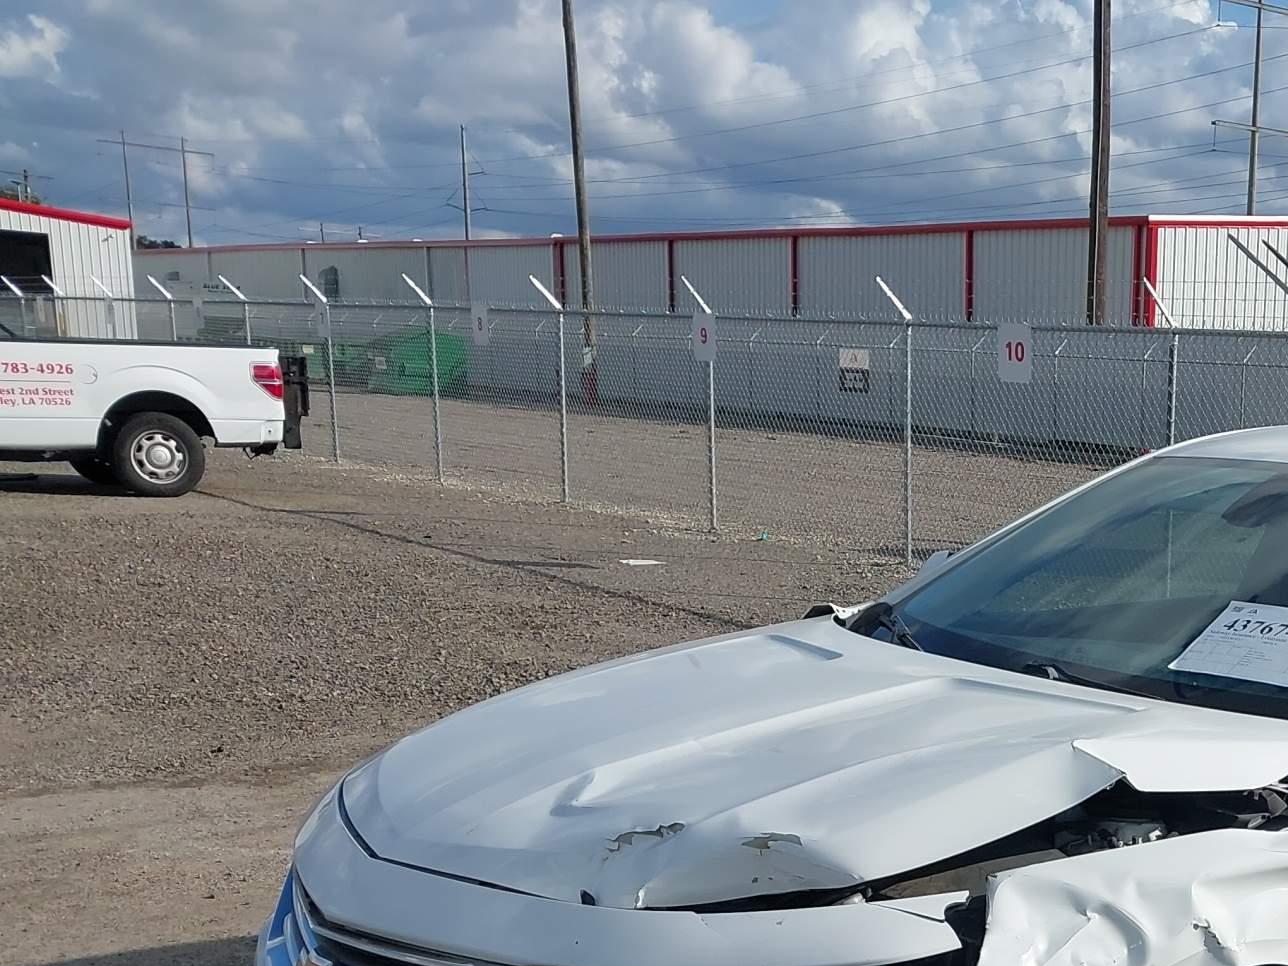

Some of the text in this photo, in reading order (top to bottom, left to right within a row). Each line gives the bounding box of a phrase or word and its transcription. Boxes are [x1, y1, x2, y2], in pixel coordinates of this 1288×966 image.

[477, 316, 483, 331] 8
[700, 327, 708, 344] 9
[1005, 341, 1025, 362] 10
[0, 362, 74, 375] 783-4926
[18, 387, 39, 396] 2nd
[41, 387, 74, 397] Street
[21, 397, 36, 406] LA
[39, 397, 72, 406] 70526
